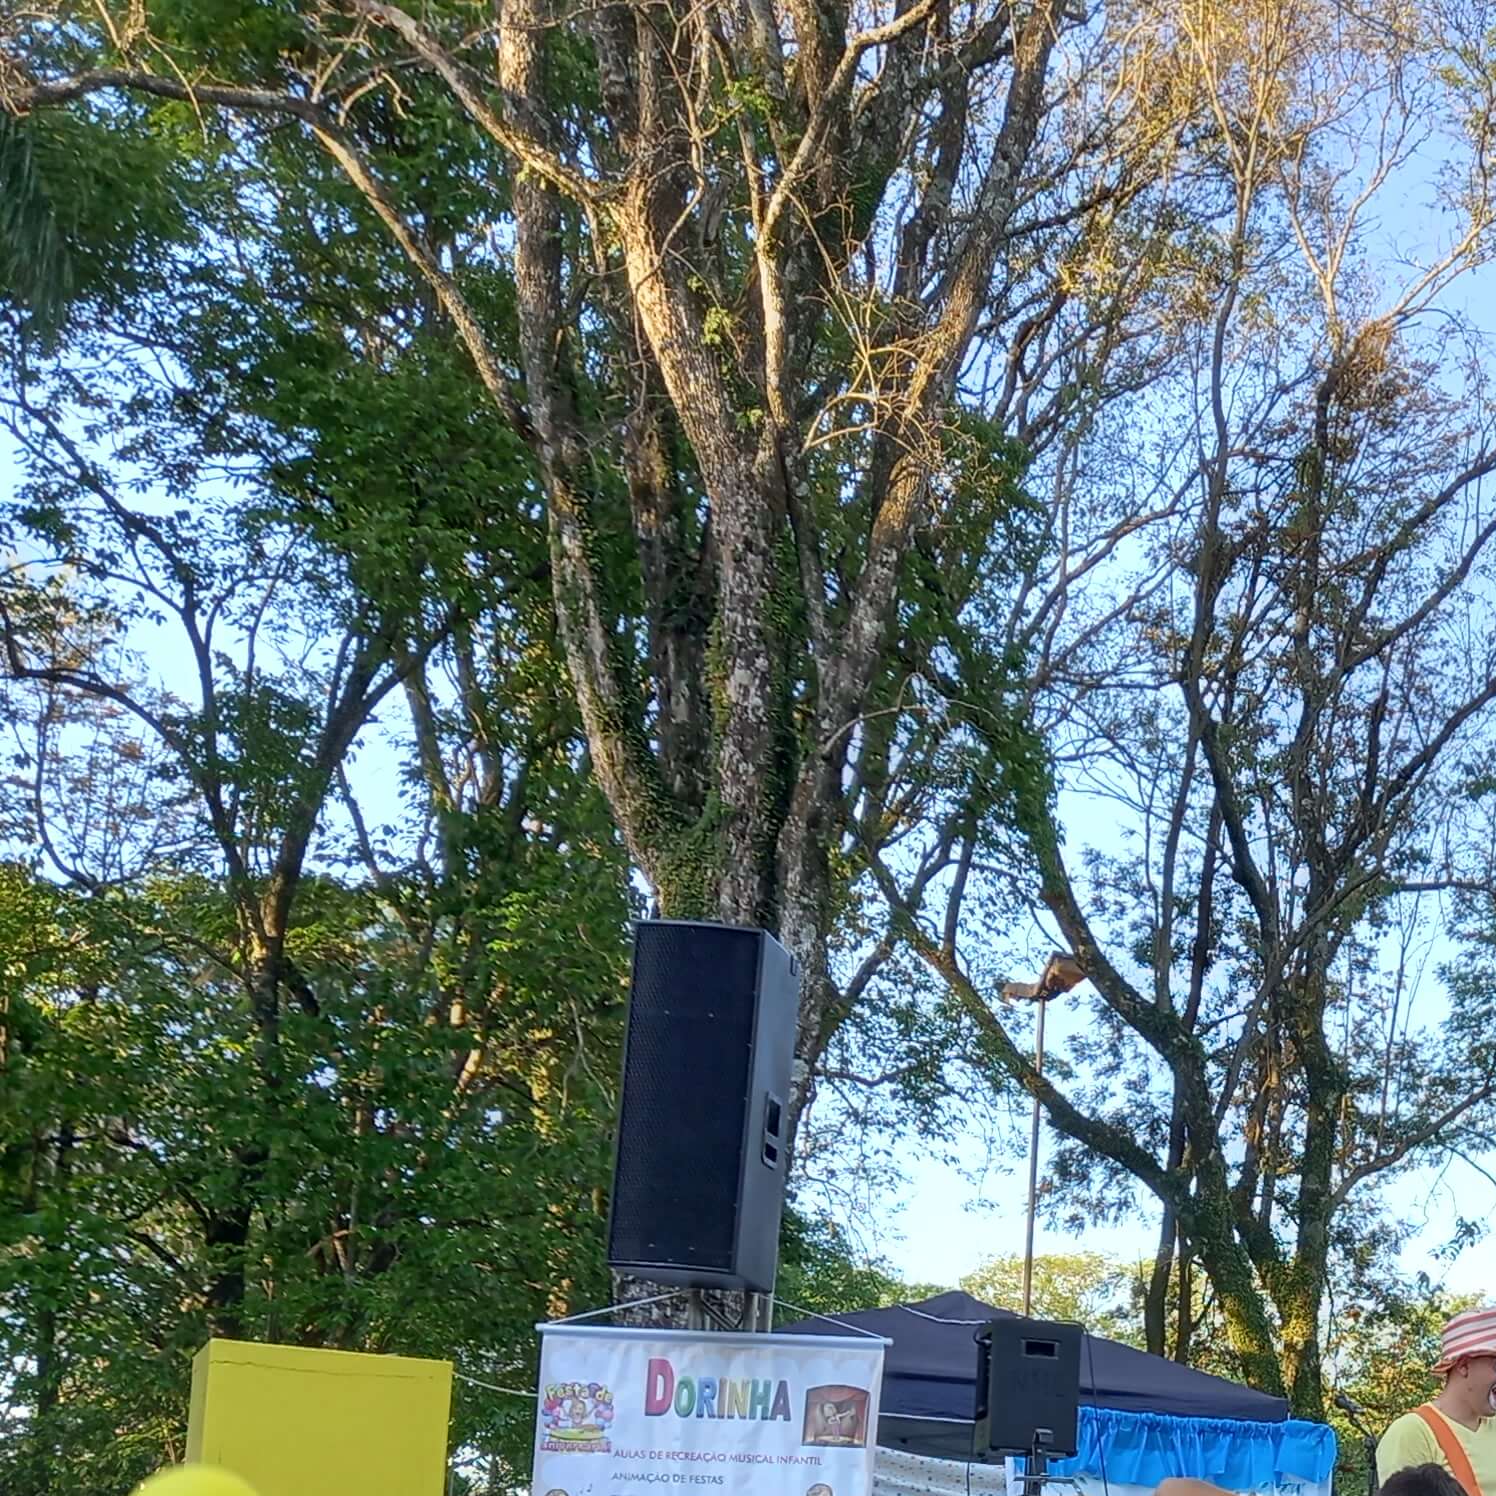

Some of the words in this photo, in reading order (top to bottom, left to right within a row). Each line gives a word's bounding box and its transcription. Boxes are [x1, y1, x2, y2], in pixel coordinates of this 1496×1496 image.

[644, 1358, 792, 1421] DORINHA
[613, 1449, 647, 1460] AULAS
[648, 1450, 664, 1460] DE
[729, 1453, 776, 1464] MUSICAL
[777, 1455, 823, 1466] INFANTIL
[672, 1473, 688, 1484] DE
[689, 1474, 725, 1486] FESTAS
